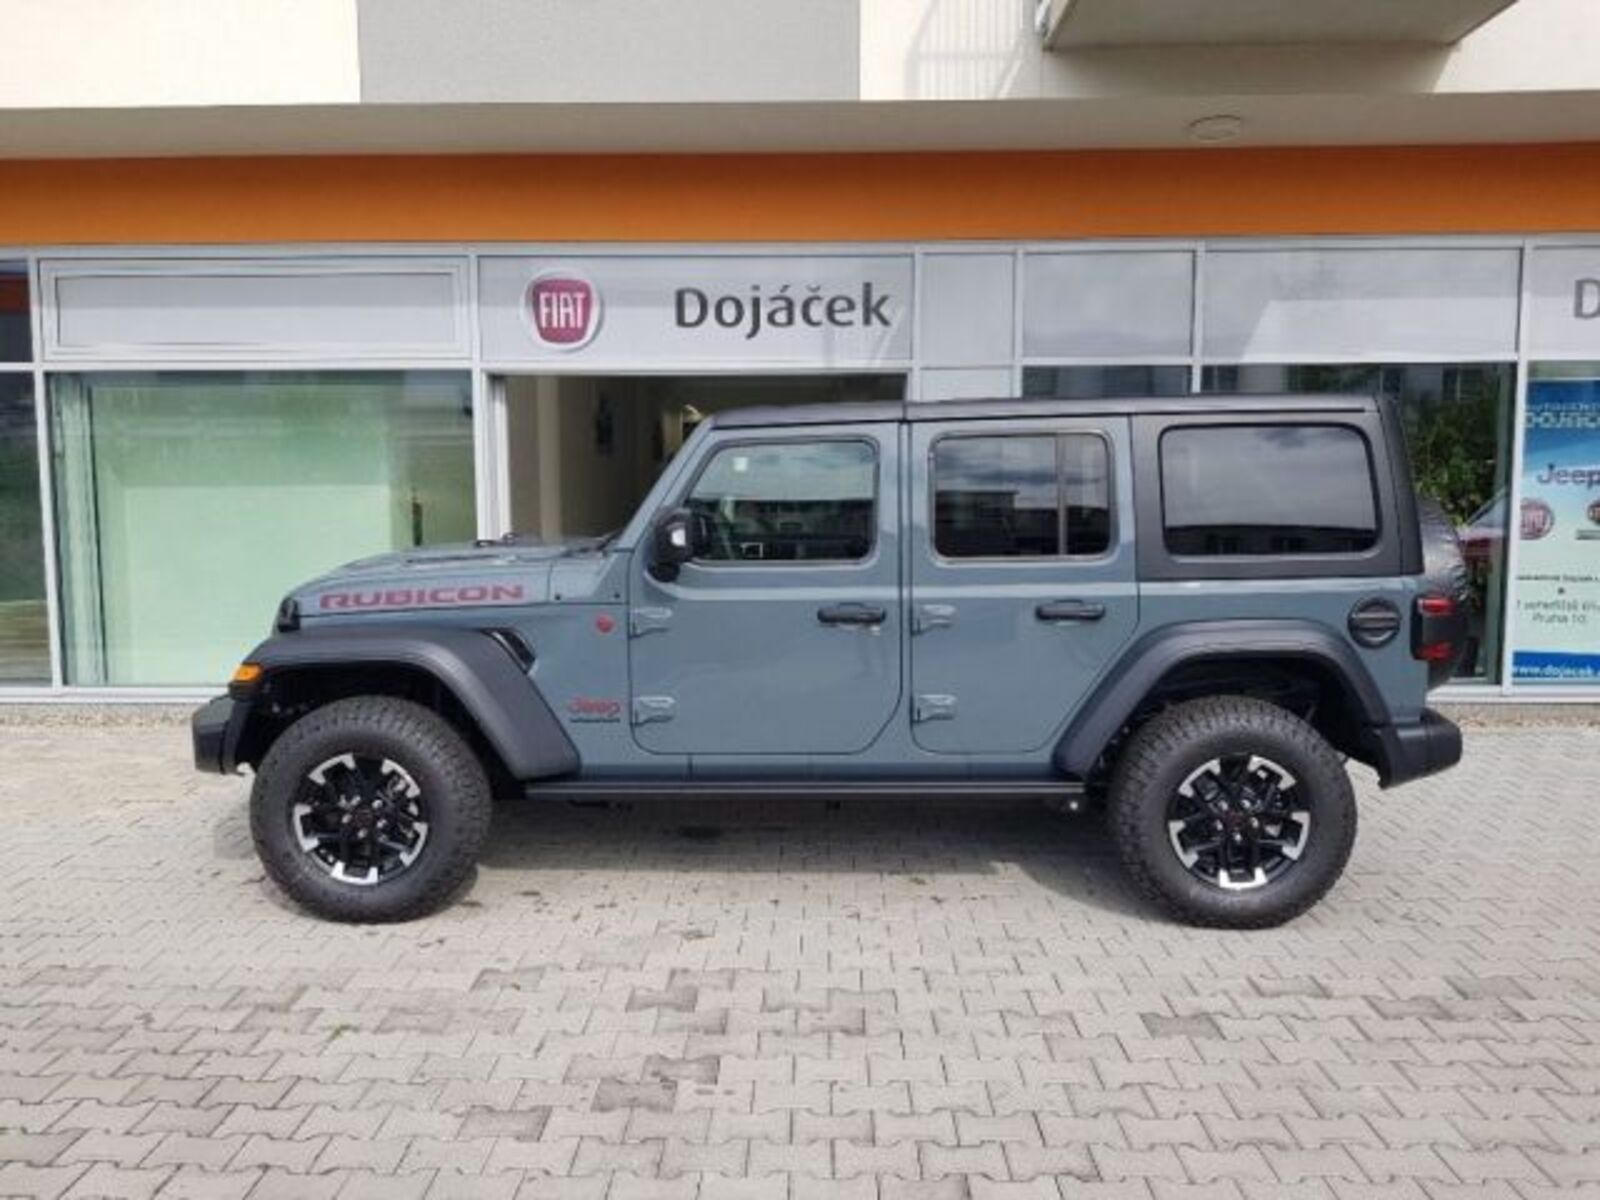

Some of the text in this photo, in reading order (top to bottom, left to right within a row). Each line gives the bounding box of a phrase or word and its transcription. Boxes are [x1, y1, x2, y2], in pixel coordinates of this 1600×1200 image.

[539, 291, 586, 328] FIAT
[674, 282, 892, 340] Dojáček
[319, 584, 524, 610] RUBICON
[567, 696, 621, 718] Jeep
